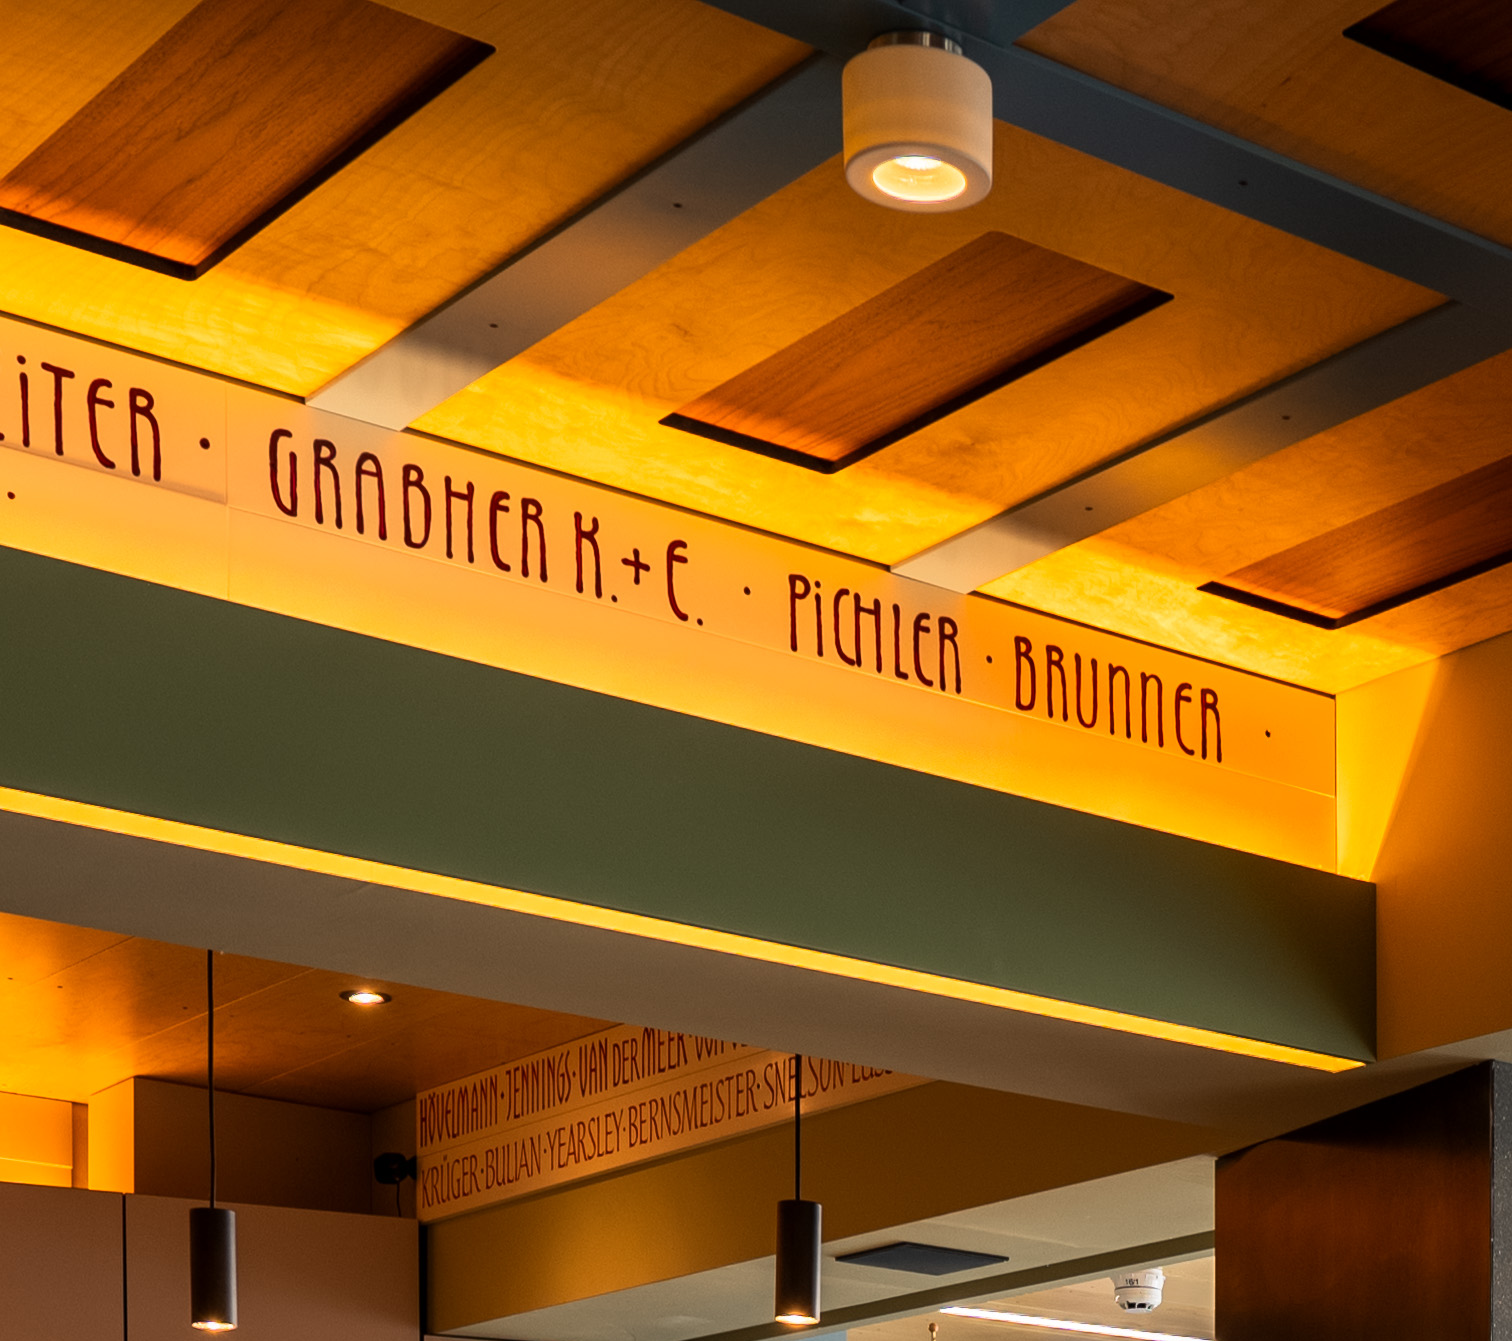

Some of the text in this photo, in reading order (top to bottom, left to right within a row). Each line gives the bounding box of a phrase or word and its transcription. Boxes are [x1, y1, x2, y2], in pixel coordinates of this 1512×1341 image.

[268, 428, 549, 583] GRABHER
[1014, 634, 1223, 762] BRUNNER
[421, 1153, 482, 1209] KRÜGER
[546, 1107, 624, 1172] YEARSLEY
[628, 1068, 761, 1149] BERNSMEISTER
[505, 1050, 573, 1122] JENNINGS
[612, 1037, 640, 1088] DER
